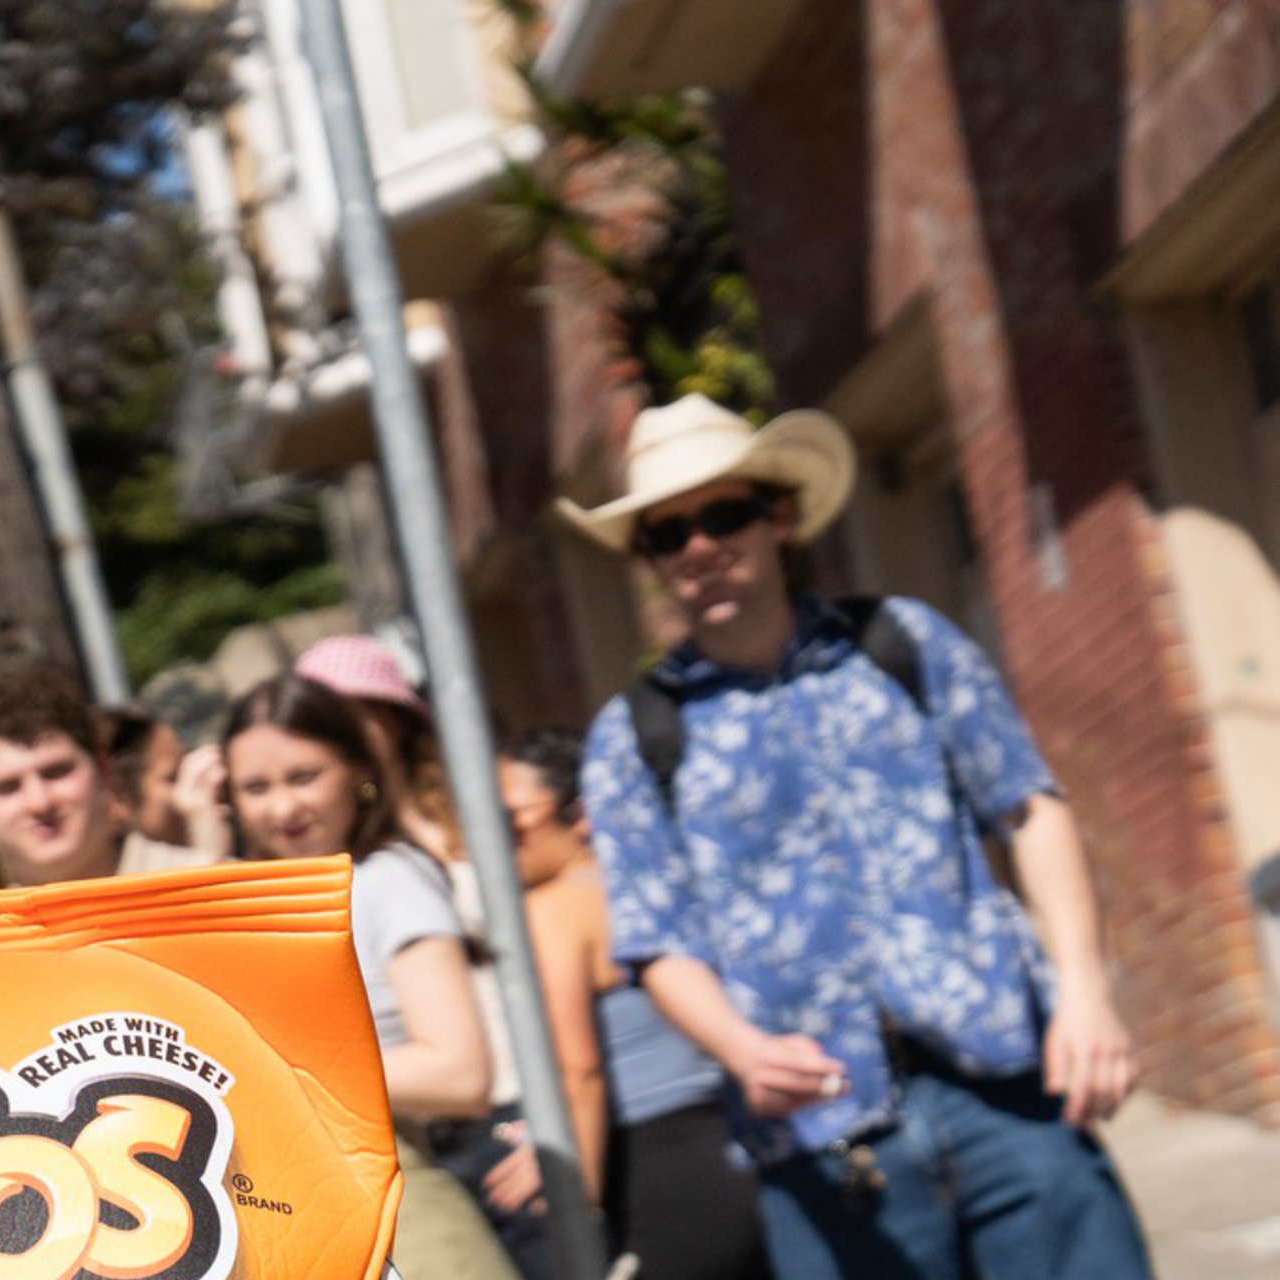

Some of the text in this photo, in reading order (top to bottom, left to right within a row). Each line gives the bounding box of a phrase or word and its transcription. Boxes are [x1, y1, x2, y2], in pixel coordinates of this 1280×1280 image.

[57, 1017, 180, 1044] MADE WITH
[17, 1034, 230, 1091] REAL CHEESE!
[235, 1193, 294, 1216] BRAND
